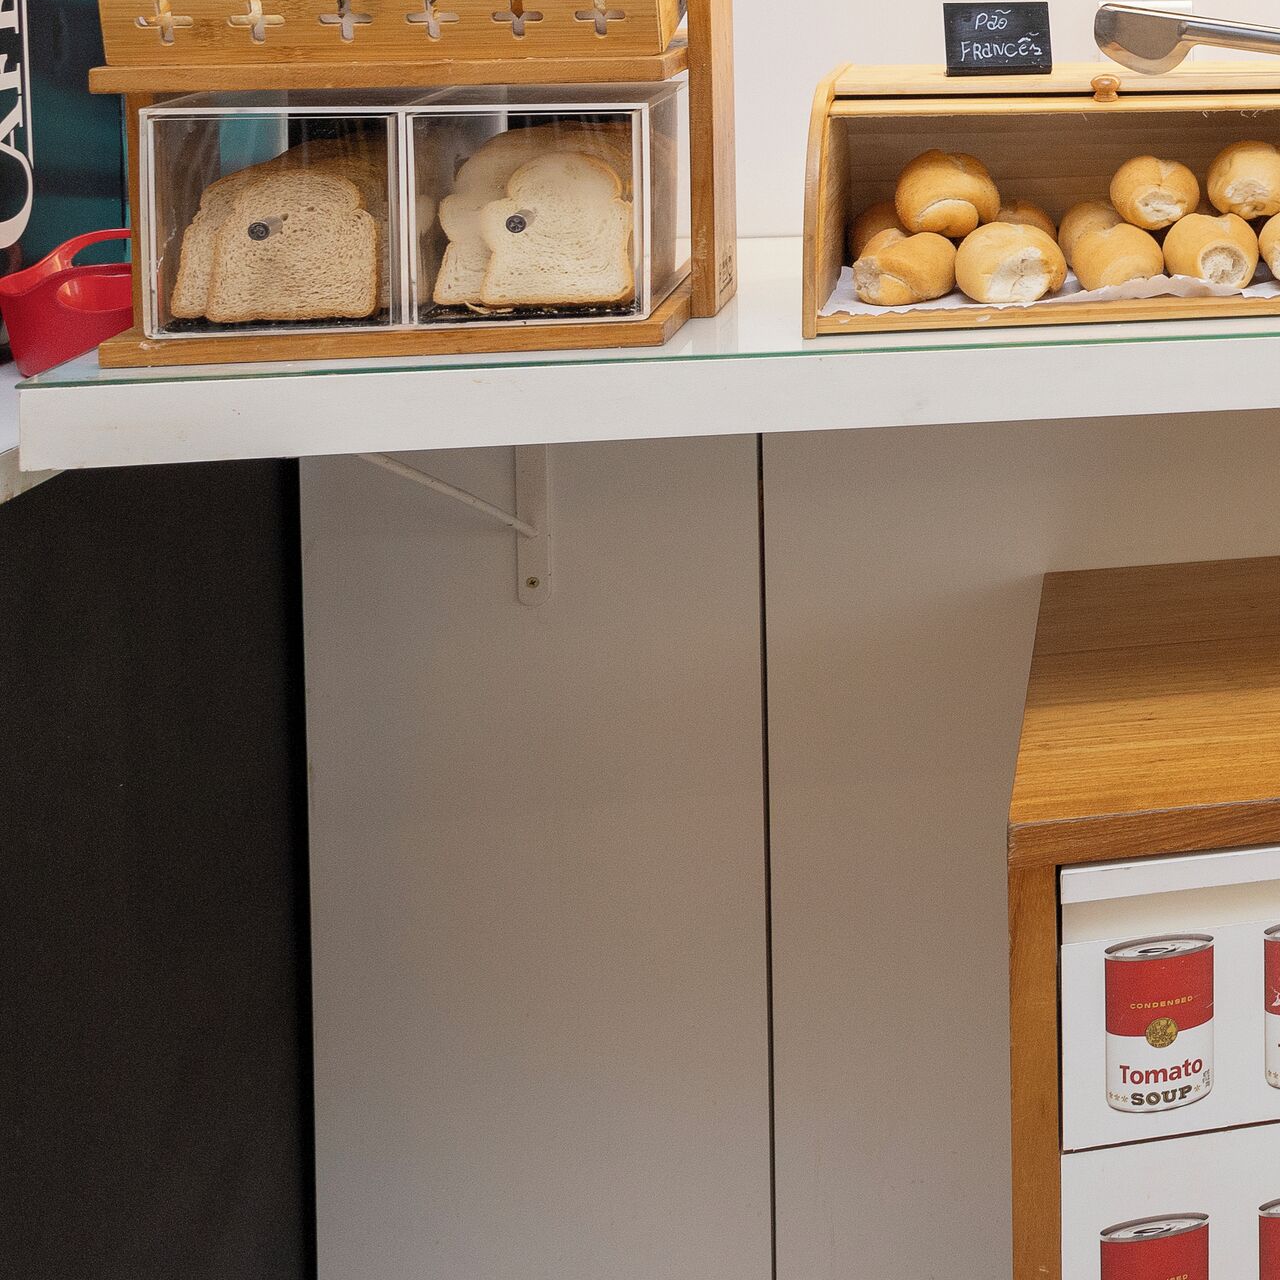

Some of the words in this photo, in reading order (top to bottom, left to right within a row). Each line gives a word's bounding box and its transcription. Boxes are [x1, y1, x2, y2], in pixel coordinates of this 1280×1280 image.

[975, 9, 1012, 30] Pão
[1130, 995, 1193, 1010] CONDENSED
[1120, 1056, 1202, 1085] Tomato
[1130, 1084, 1192, 1106] SOUP
